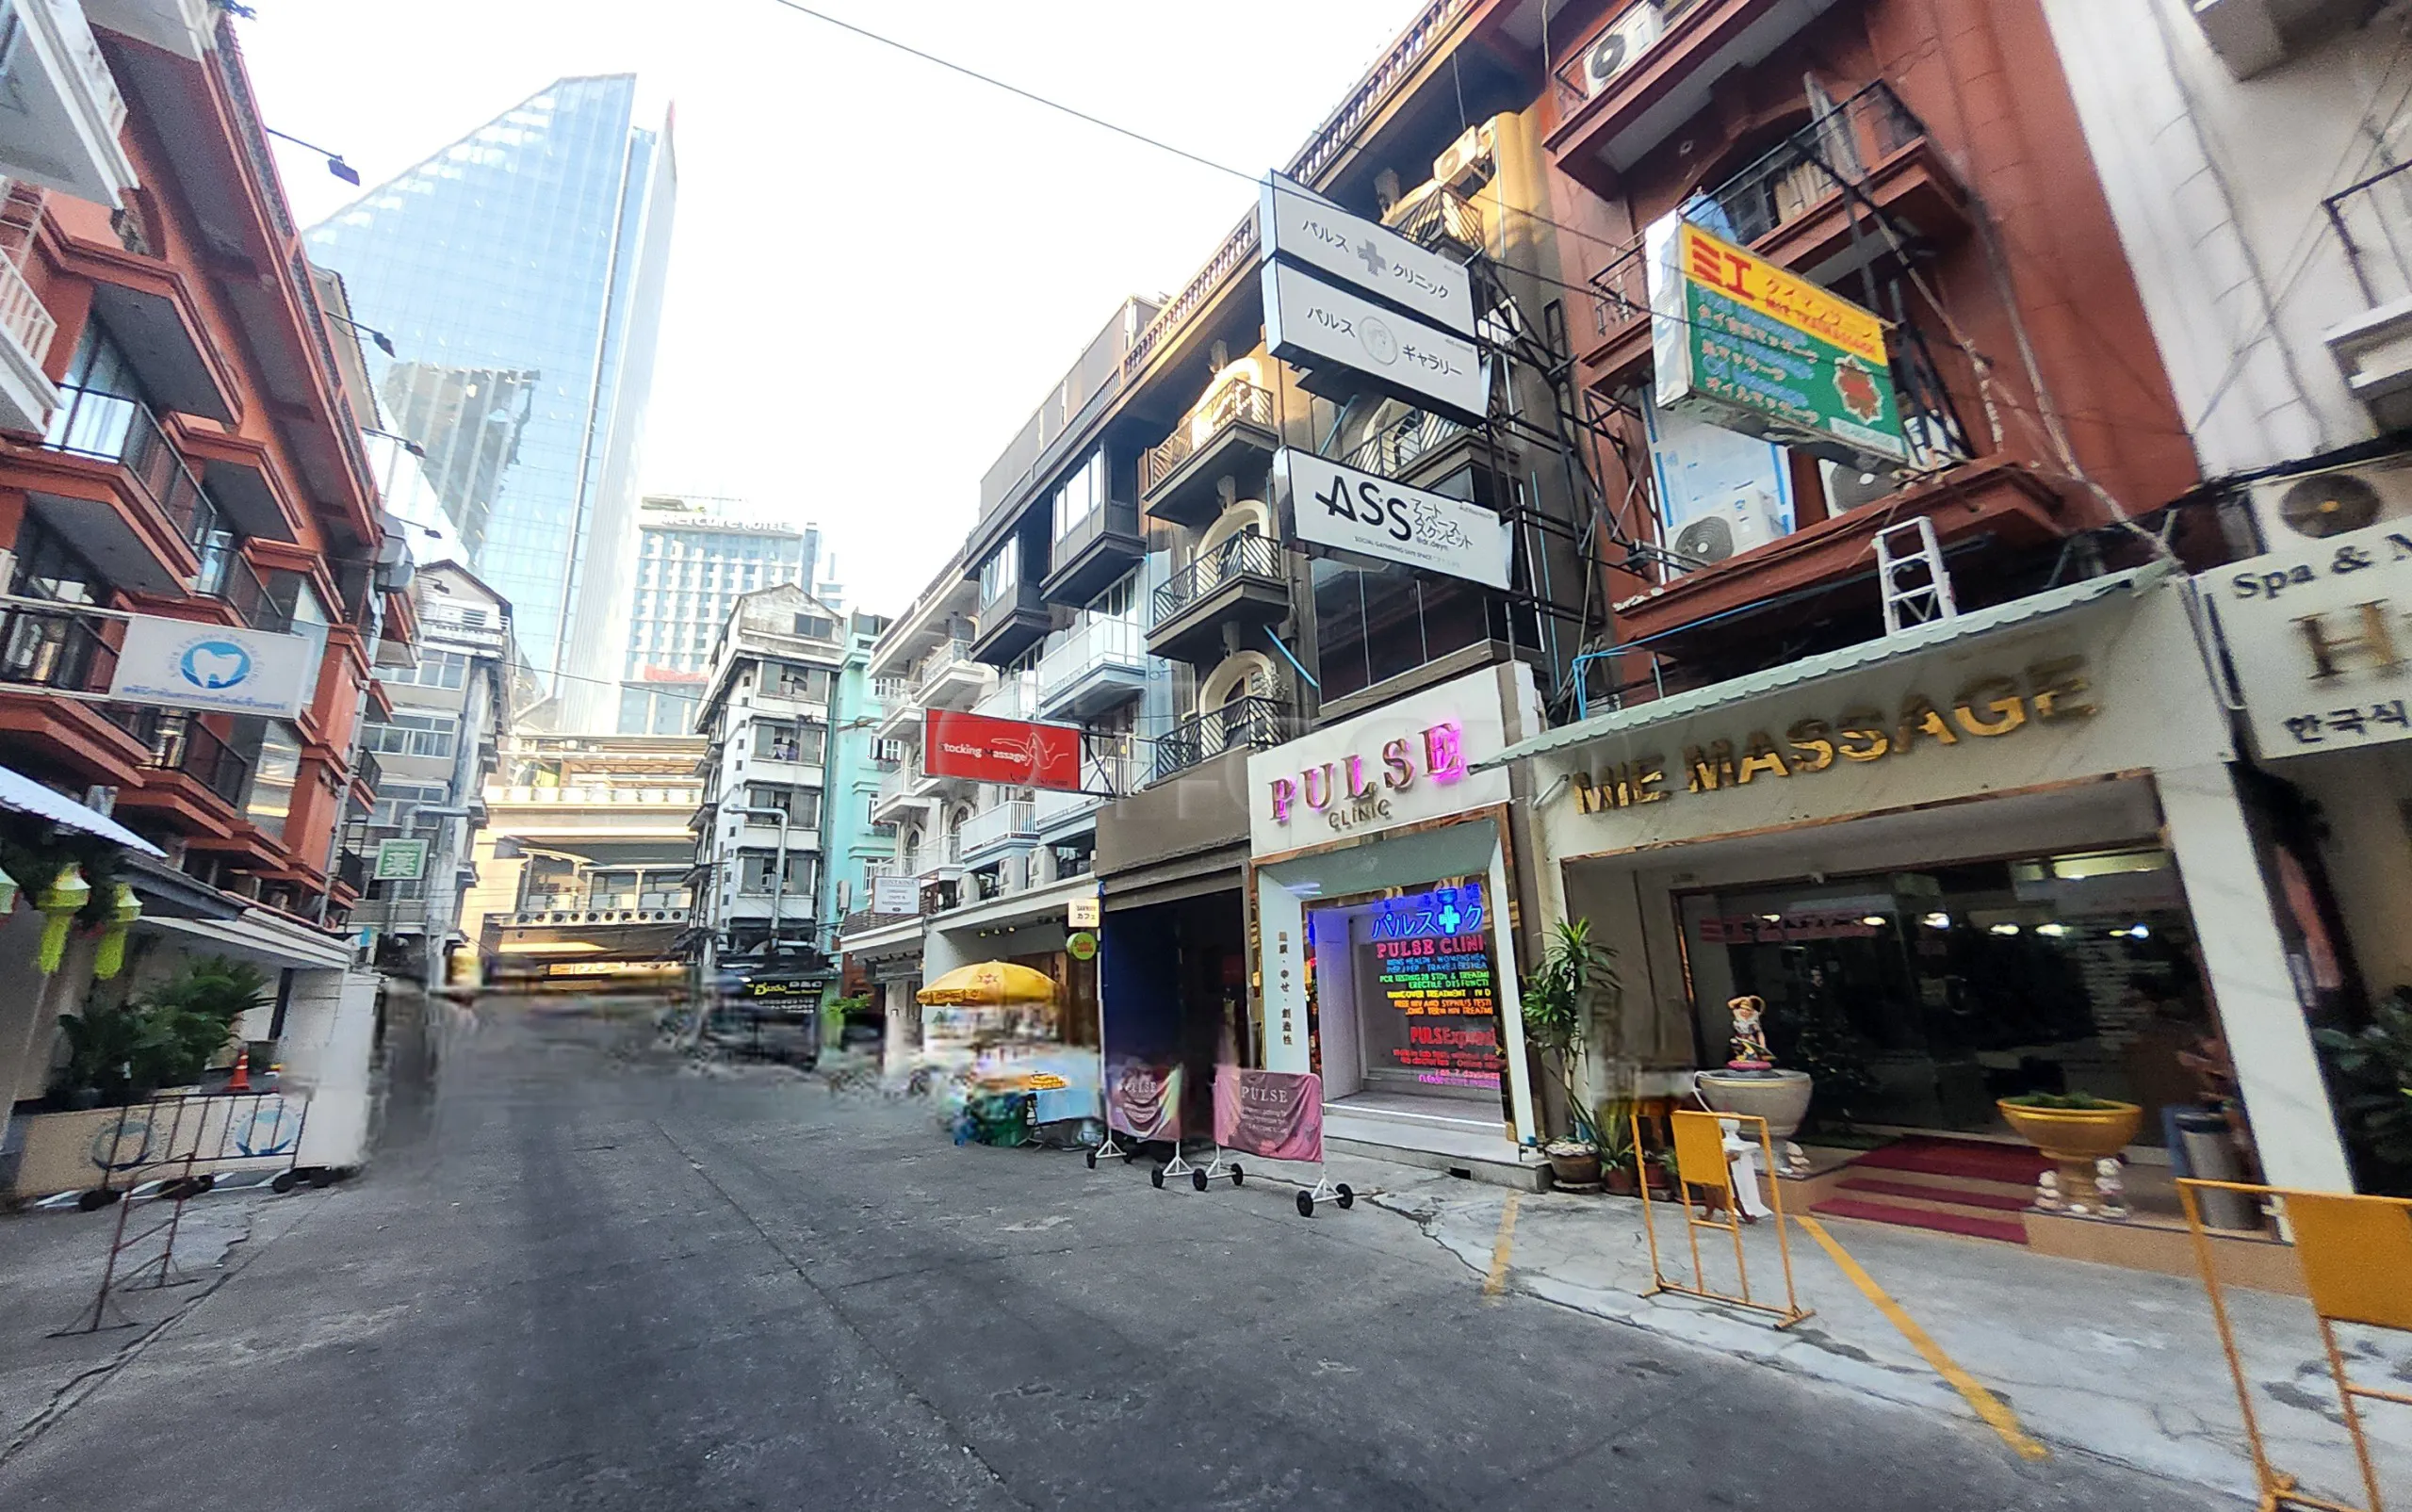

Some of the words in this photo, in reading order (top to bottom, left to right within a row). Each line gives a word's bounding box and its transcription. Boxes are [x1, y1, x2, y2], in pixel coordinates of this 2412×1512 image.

[1302, 218, 1351, 254] パルス
[1392, 262, 1450, 300] クリニック
[1307, 306, 1357, 339] パルス
[1401, 343, 1464, 378] ギャラリー
[1410, 497, 1443, 518] アート
[2232, 564, 2317, 600] Spa
[2330, 545, 2372, 574] &
[1687, 656, 2099, 792] MASSAGE
[1268, 722, 1462, 821] PULSE
[1328, 798, 1392, 830] CLINIC
[1372, 909, 1439, 939] パルス
[1376, 939, 1435, 959] PULSE
[1241, 1085, 1288, 1104] PULSE
